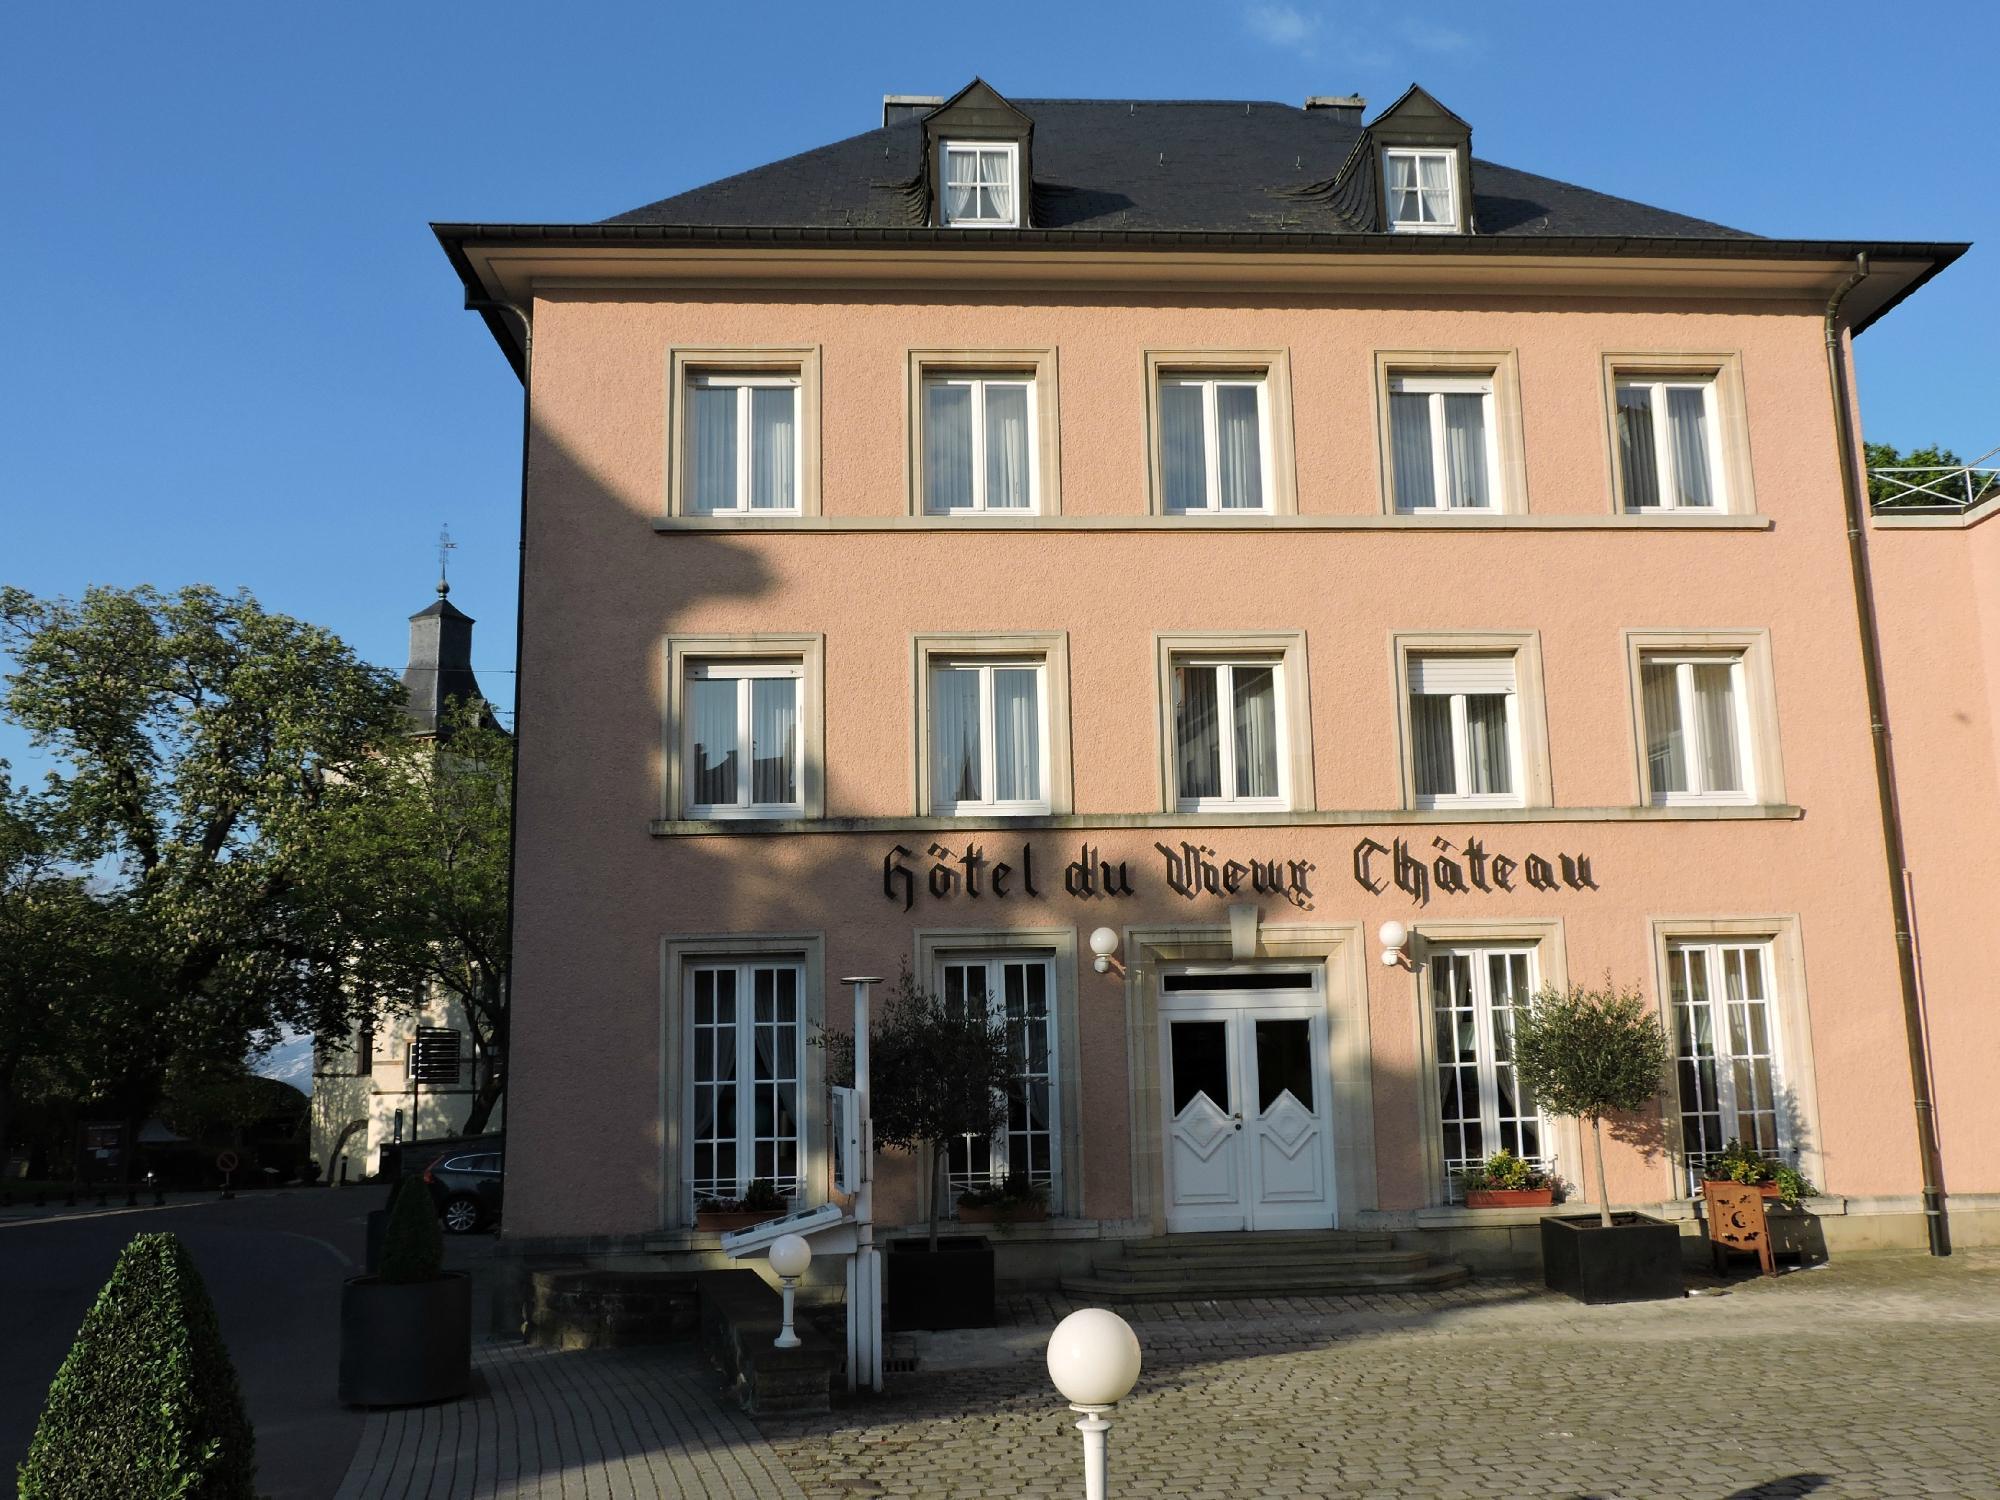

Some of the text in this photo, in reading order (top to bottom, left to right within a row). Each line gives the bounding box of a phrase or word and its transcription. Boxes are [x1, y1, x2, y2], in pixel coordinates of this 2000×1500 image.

[884, 836, 1597, 913] Hôtel du Vieux Château
